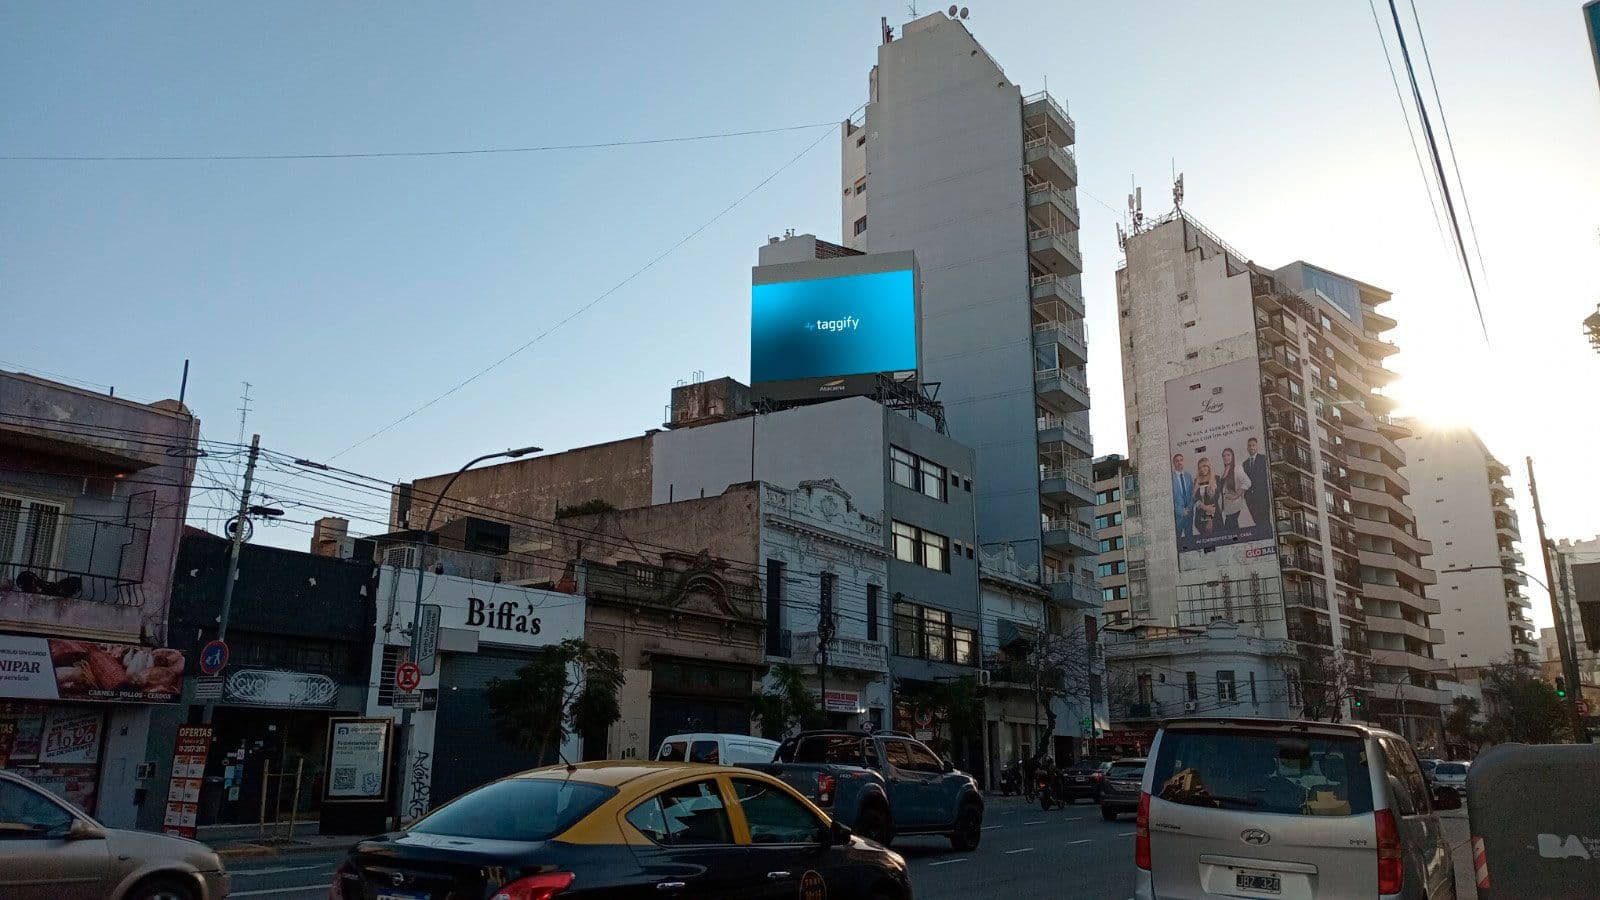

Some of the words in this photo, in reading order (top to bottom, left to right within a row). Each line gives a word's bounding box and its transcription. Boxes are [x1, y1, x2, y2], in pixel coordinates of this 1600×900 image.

[816, 315, 860, 332] taggify
[1246, 546, 1276, 557] GLOBAL
[465, 597, 542, 635] Biffa's
[119, 691, 143, 699] POLLOS
[179, 727, 213, 737] OFERTAS
